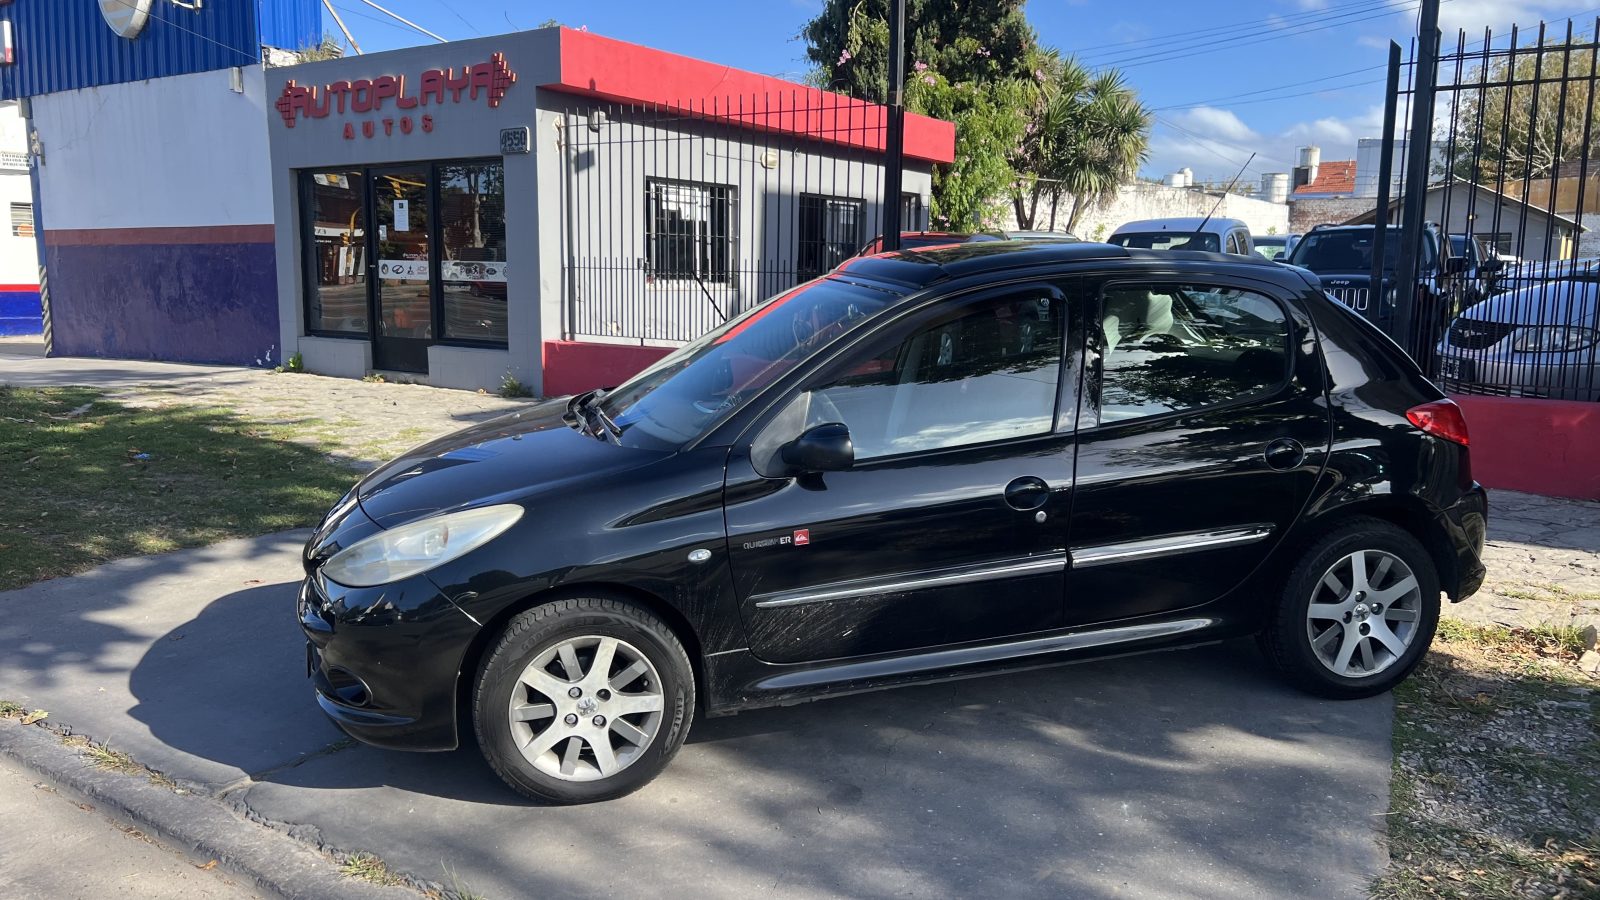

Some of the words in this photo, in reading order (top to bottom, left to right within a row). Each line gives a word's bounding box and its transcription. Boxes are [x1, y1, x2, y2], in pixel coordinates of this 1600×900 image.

[291, 62, 493, 119] AUTOPLAYA
[343, 114, 434, 140] AUTOS
[501, 130, 526, 147] 4550
